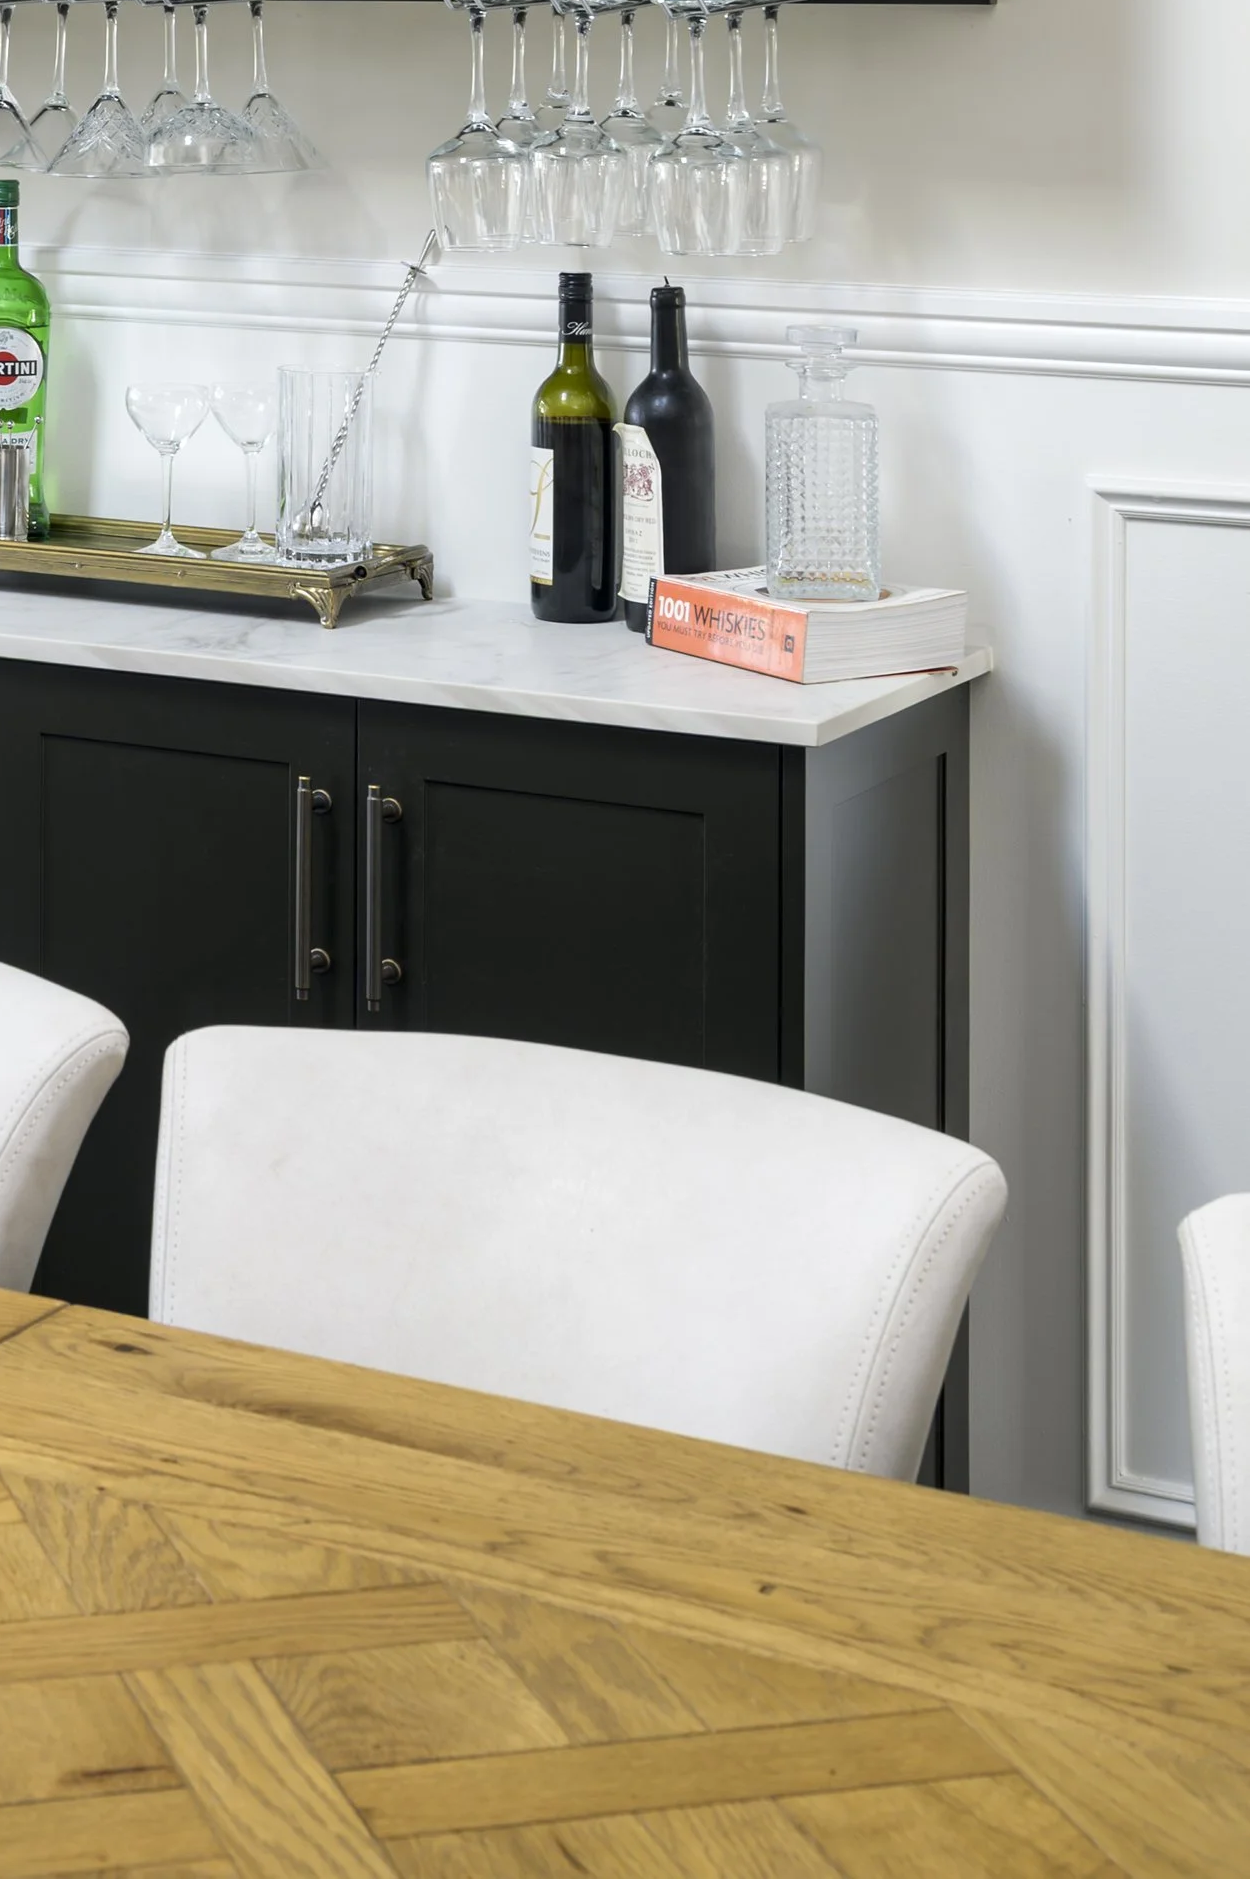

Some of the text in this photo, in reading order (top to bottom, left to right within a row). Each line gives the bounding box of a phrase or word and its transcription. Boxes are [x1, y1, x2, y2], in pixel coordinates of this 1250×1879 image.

[648, 581, 656, 609] EDITION
[658, 595, 766, 641] 1001 WHISKIES
[657, 621, 671, 632] YOU
[672, 623, 692, 637] MUST
[694, 629, 707, 640] TRY
[707, 632, 734, 648] BEFORE
